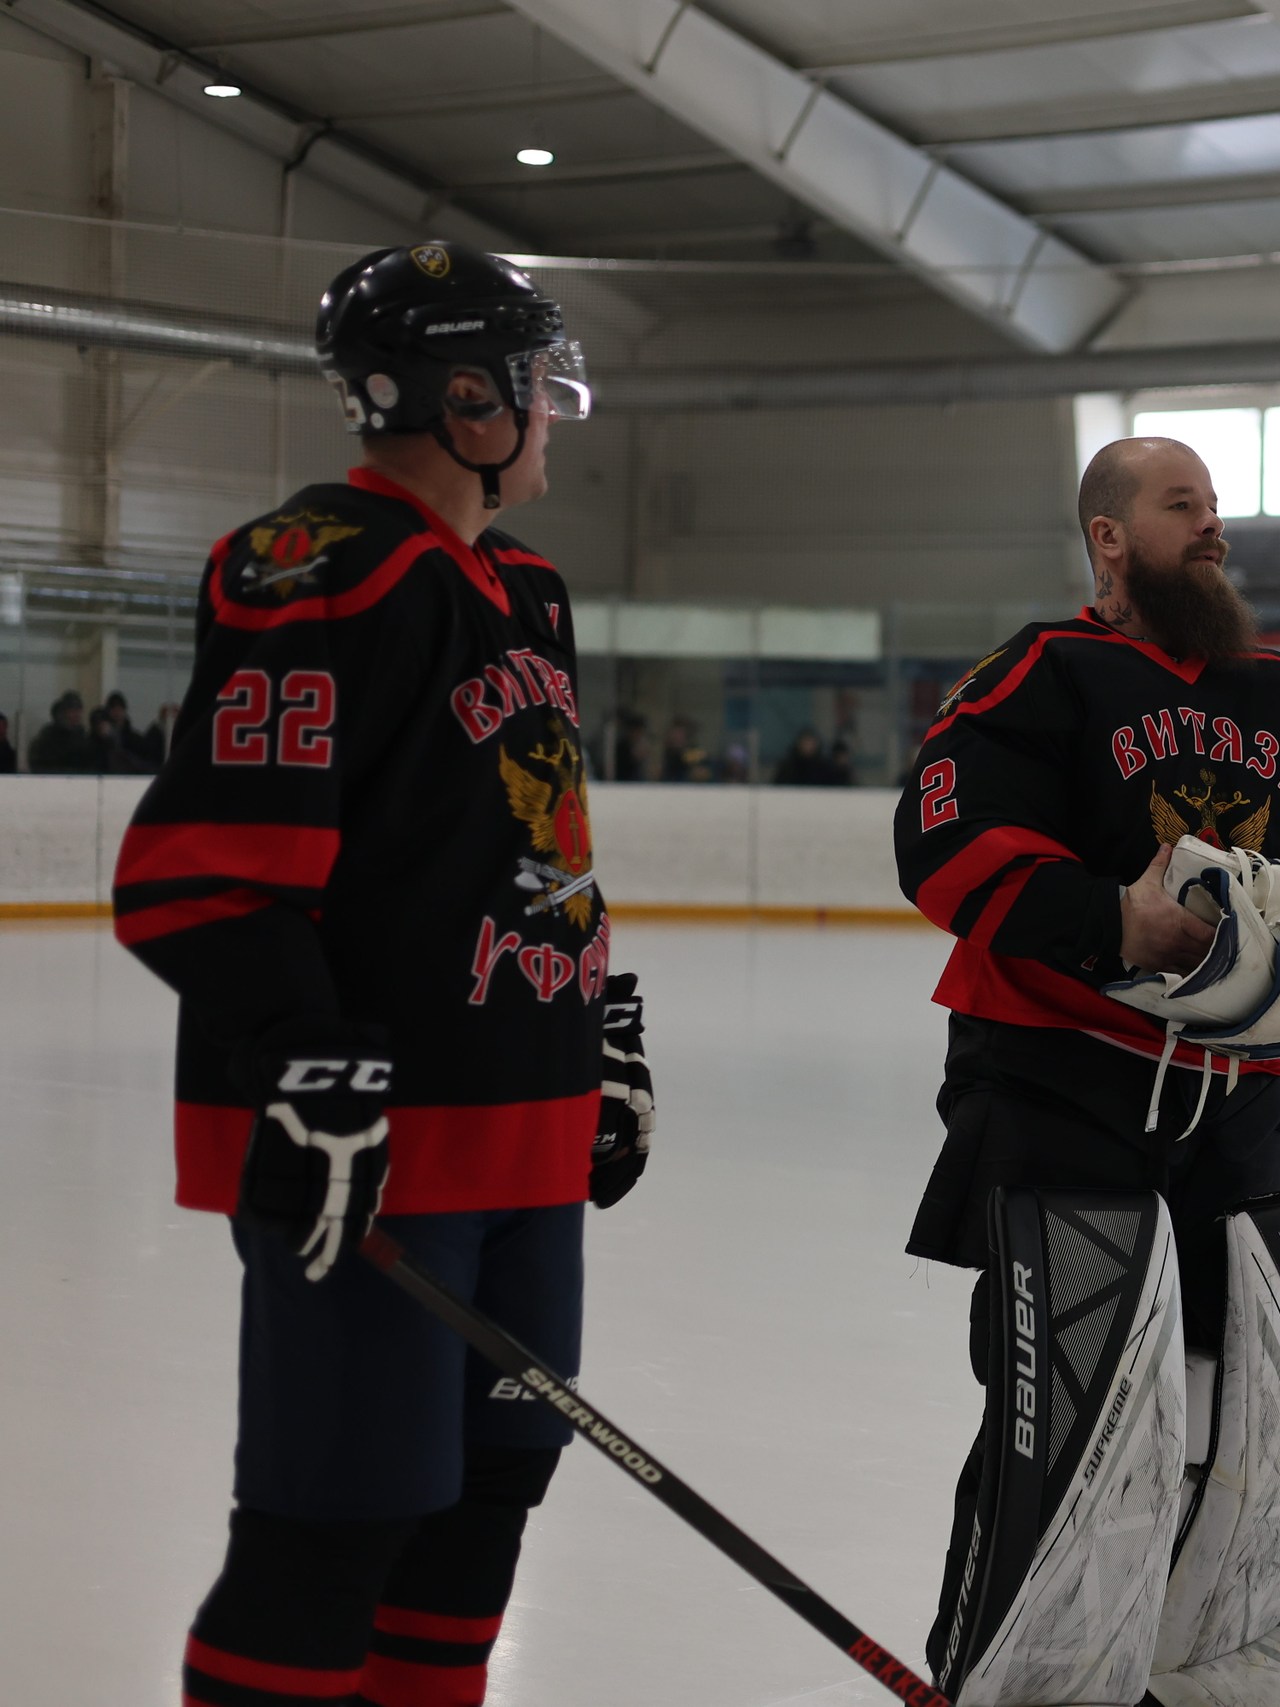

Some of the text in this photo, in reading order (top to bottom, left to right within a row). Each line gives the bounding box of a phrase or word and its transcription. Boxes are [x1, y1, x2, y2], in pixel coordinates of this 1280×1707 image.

[424, 320, 486, 336] BAUER
[212, 669, 337, 769] 22
[920, 757, 960, 834] 2
[1013, 1260, 1036, 1460] BAUER
[521, 1367, 663, 1485] SHER-WOOD
[1082, 1378, 1133, 1491] SUPREME
